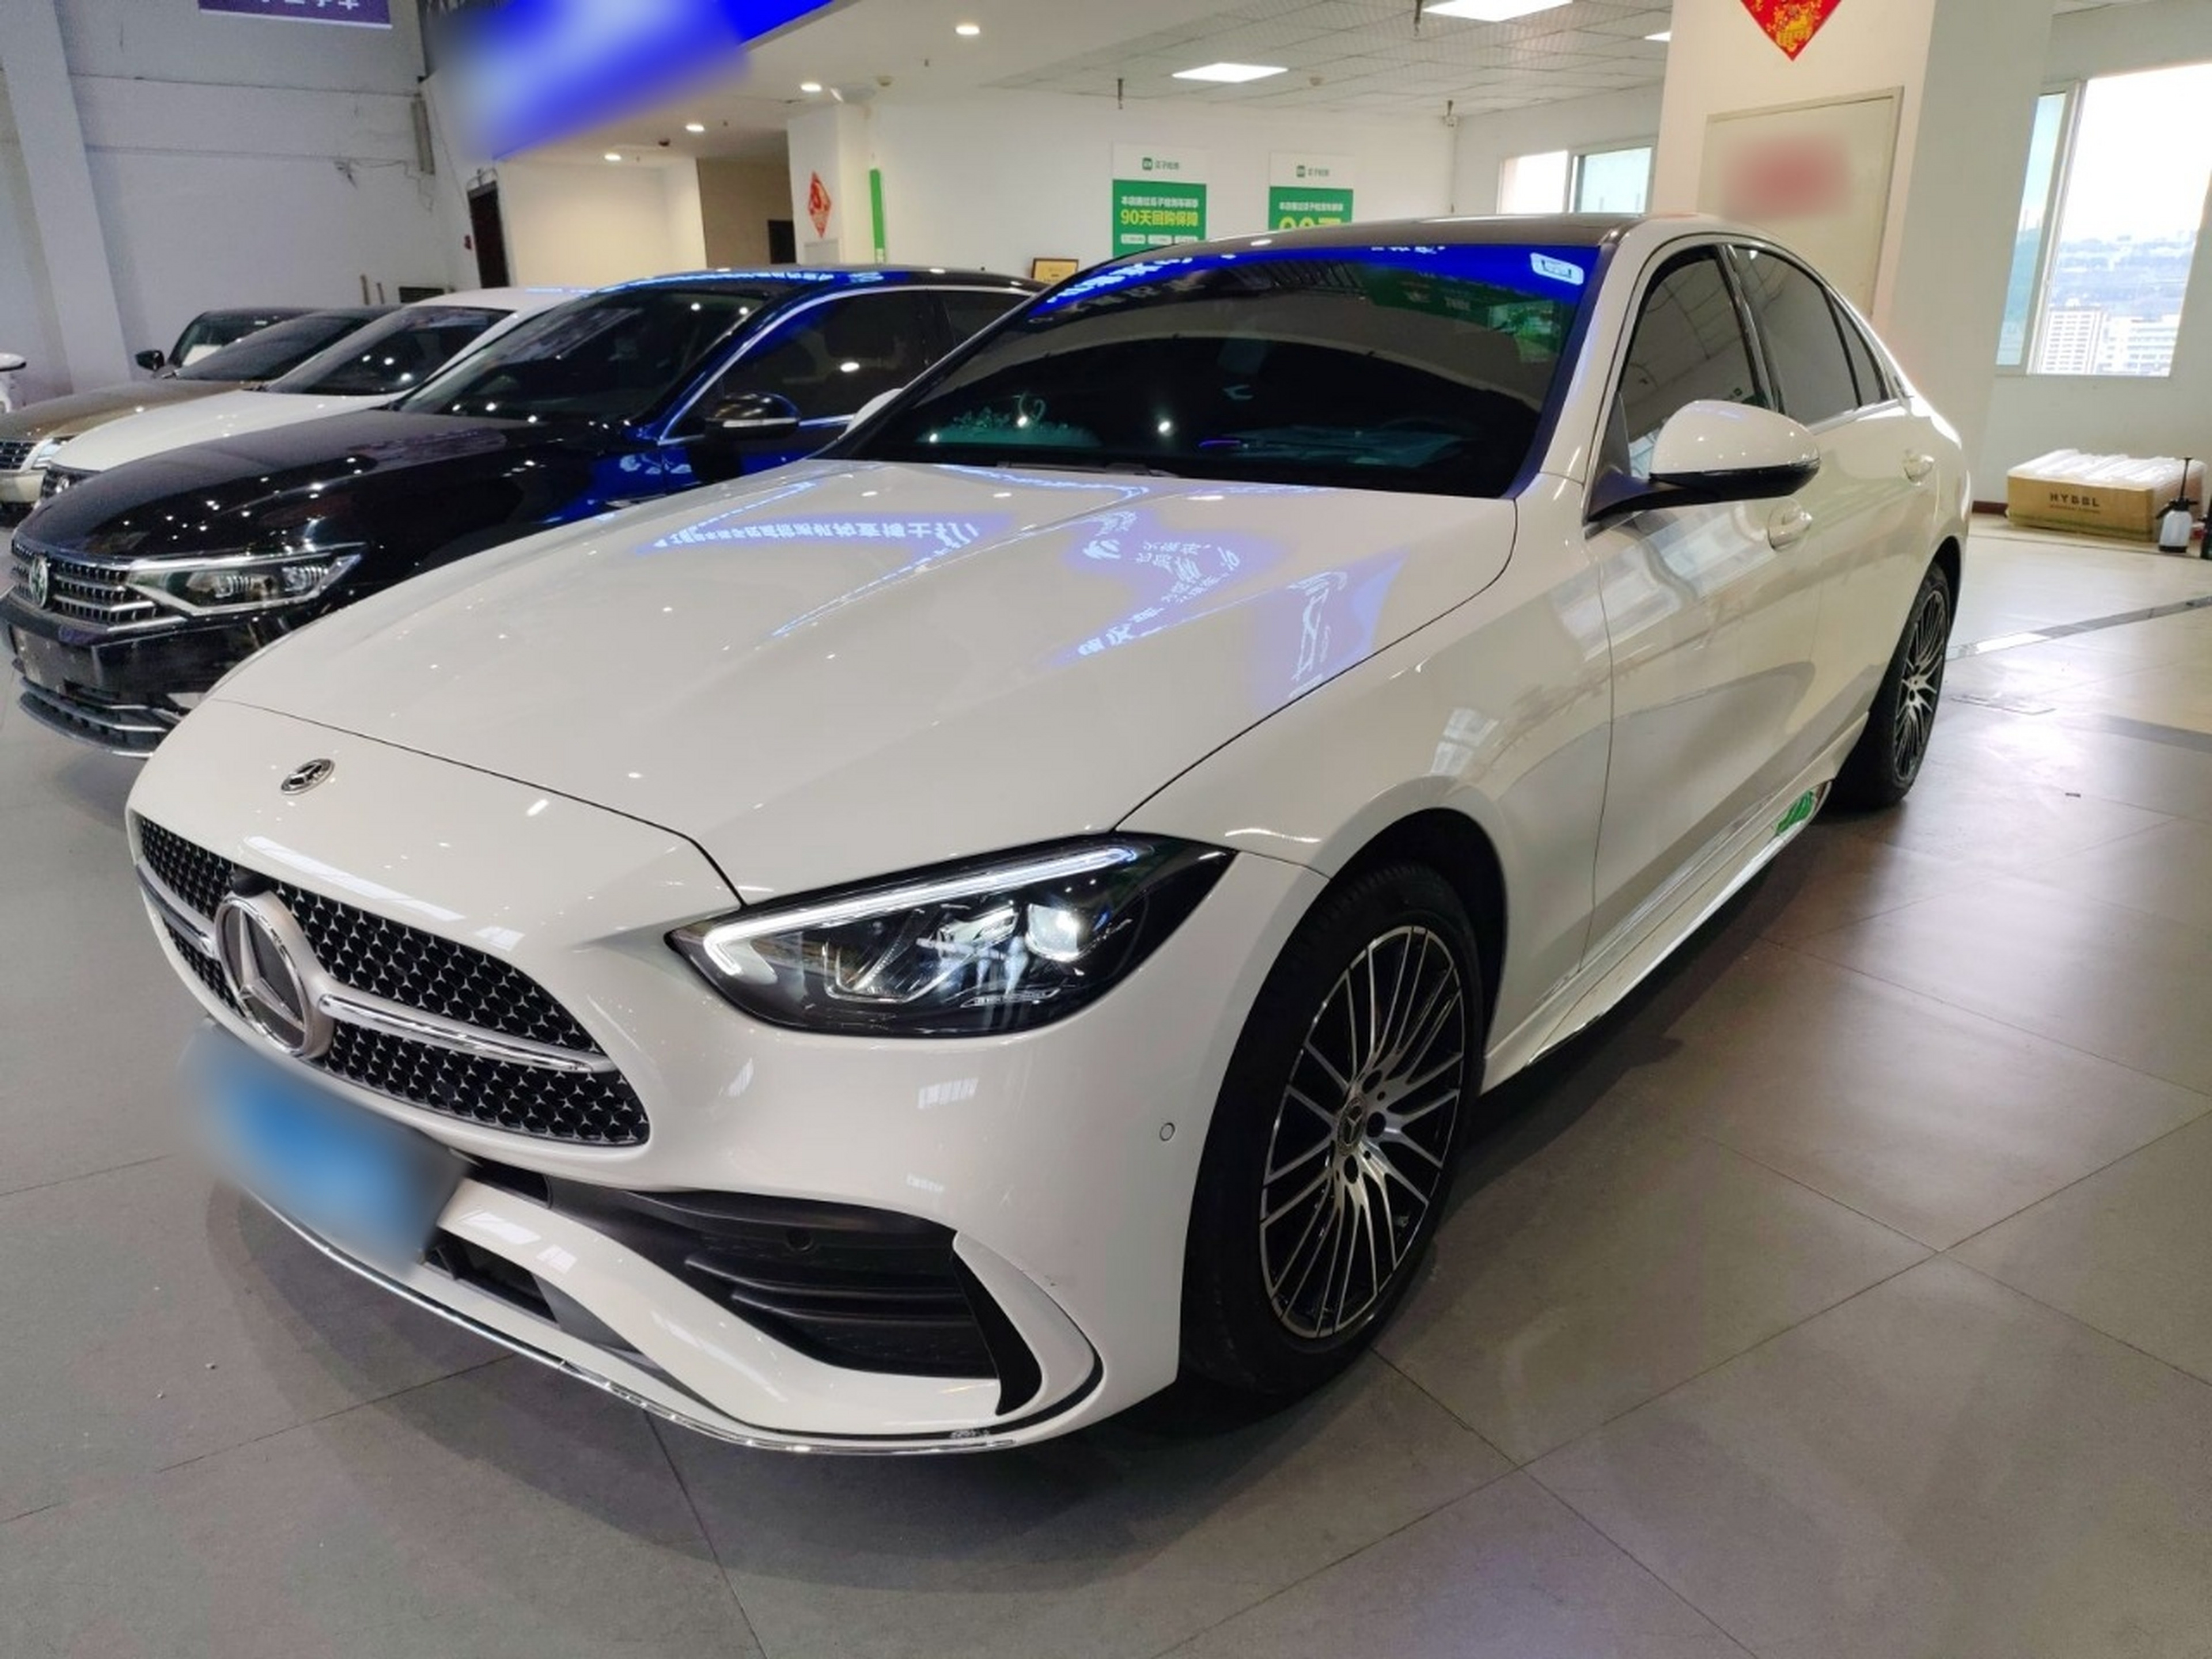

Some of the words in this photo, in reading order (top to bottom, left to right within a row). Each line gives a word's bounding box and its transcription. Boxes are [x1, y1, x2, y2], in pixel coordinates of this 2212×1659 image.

[1120, 209, 1199, 227] 90天回购保障
